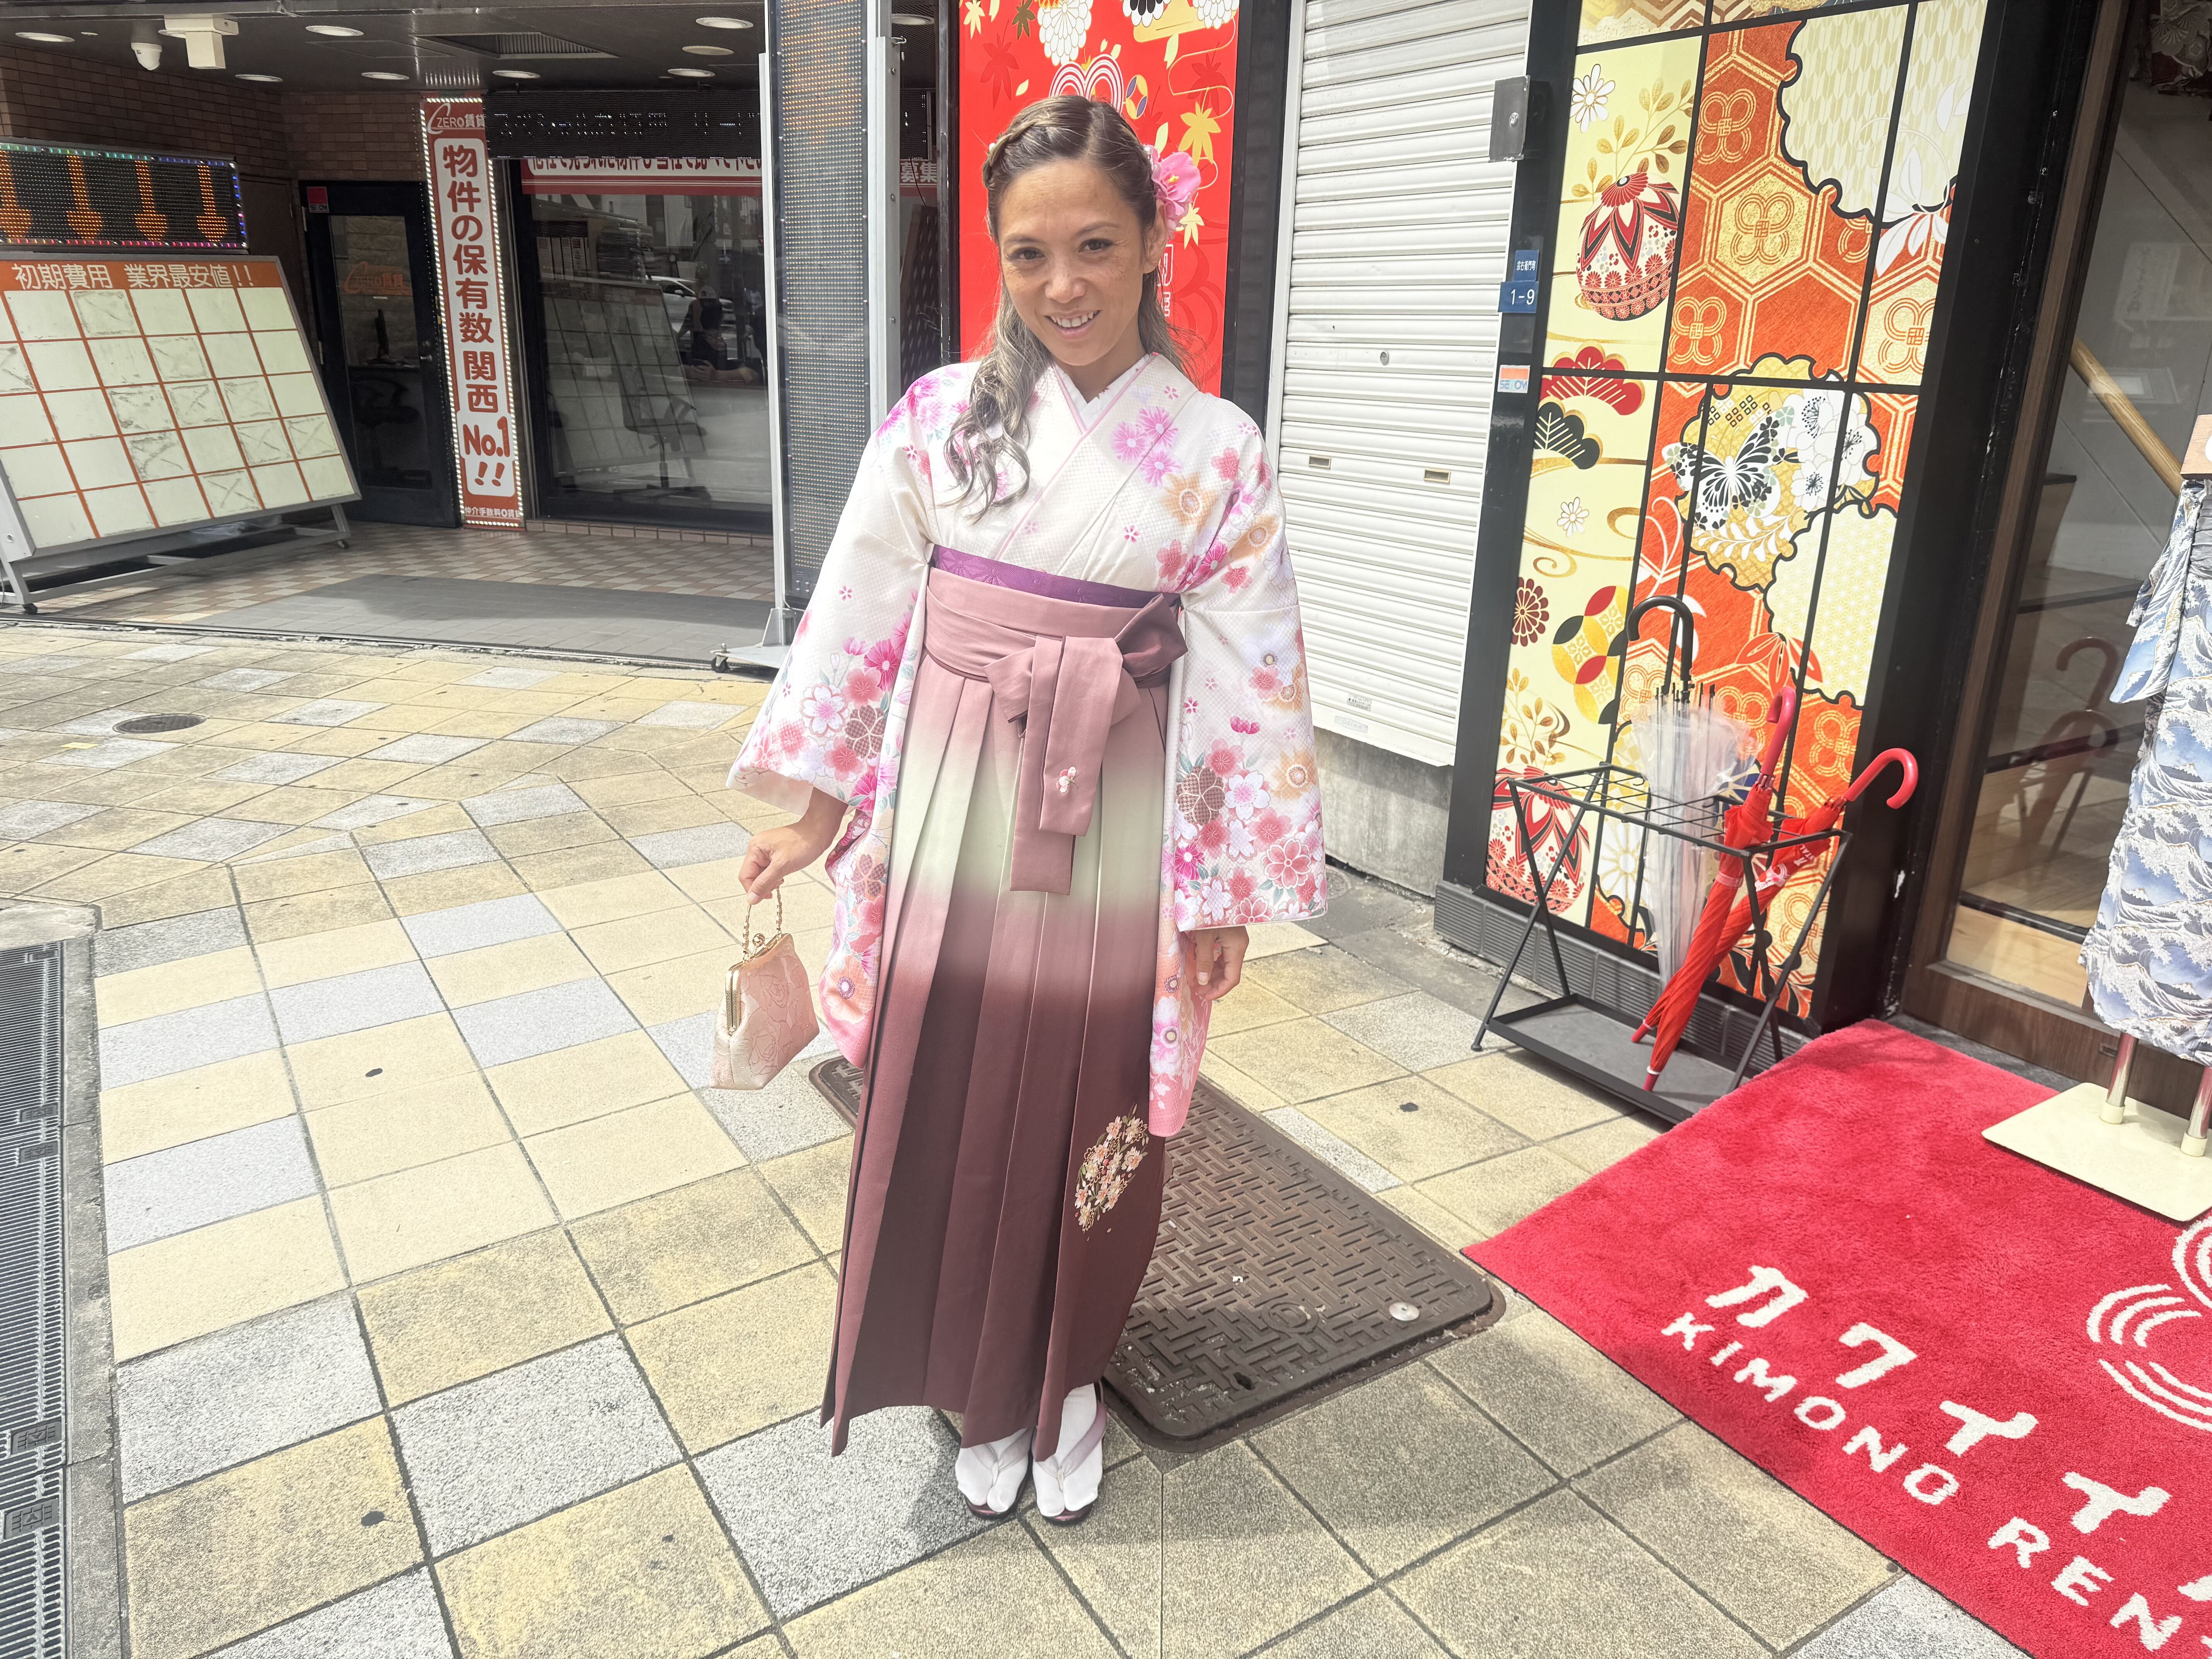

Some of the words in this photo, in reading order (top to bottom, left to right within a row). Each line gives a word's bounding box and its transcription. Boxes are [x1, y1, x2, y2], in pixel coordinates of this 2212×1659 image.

[11, 263, 113, 290] 初期費用
[1511, 289, 1535, 305] 1-9
[1661, 1312, 1960, 1505] KIMONO
